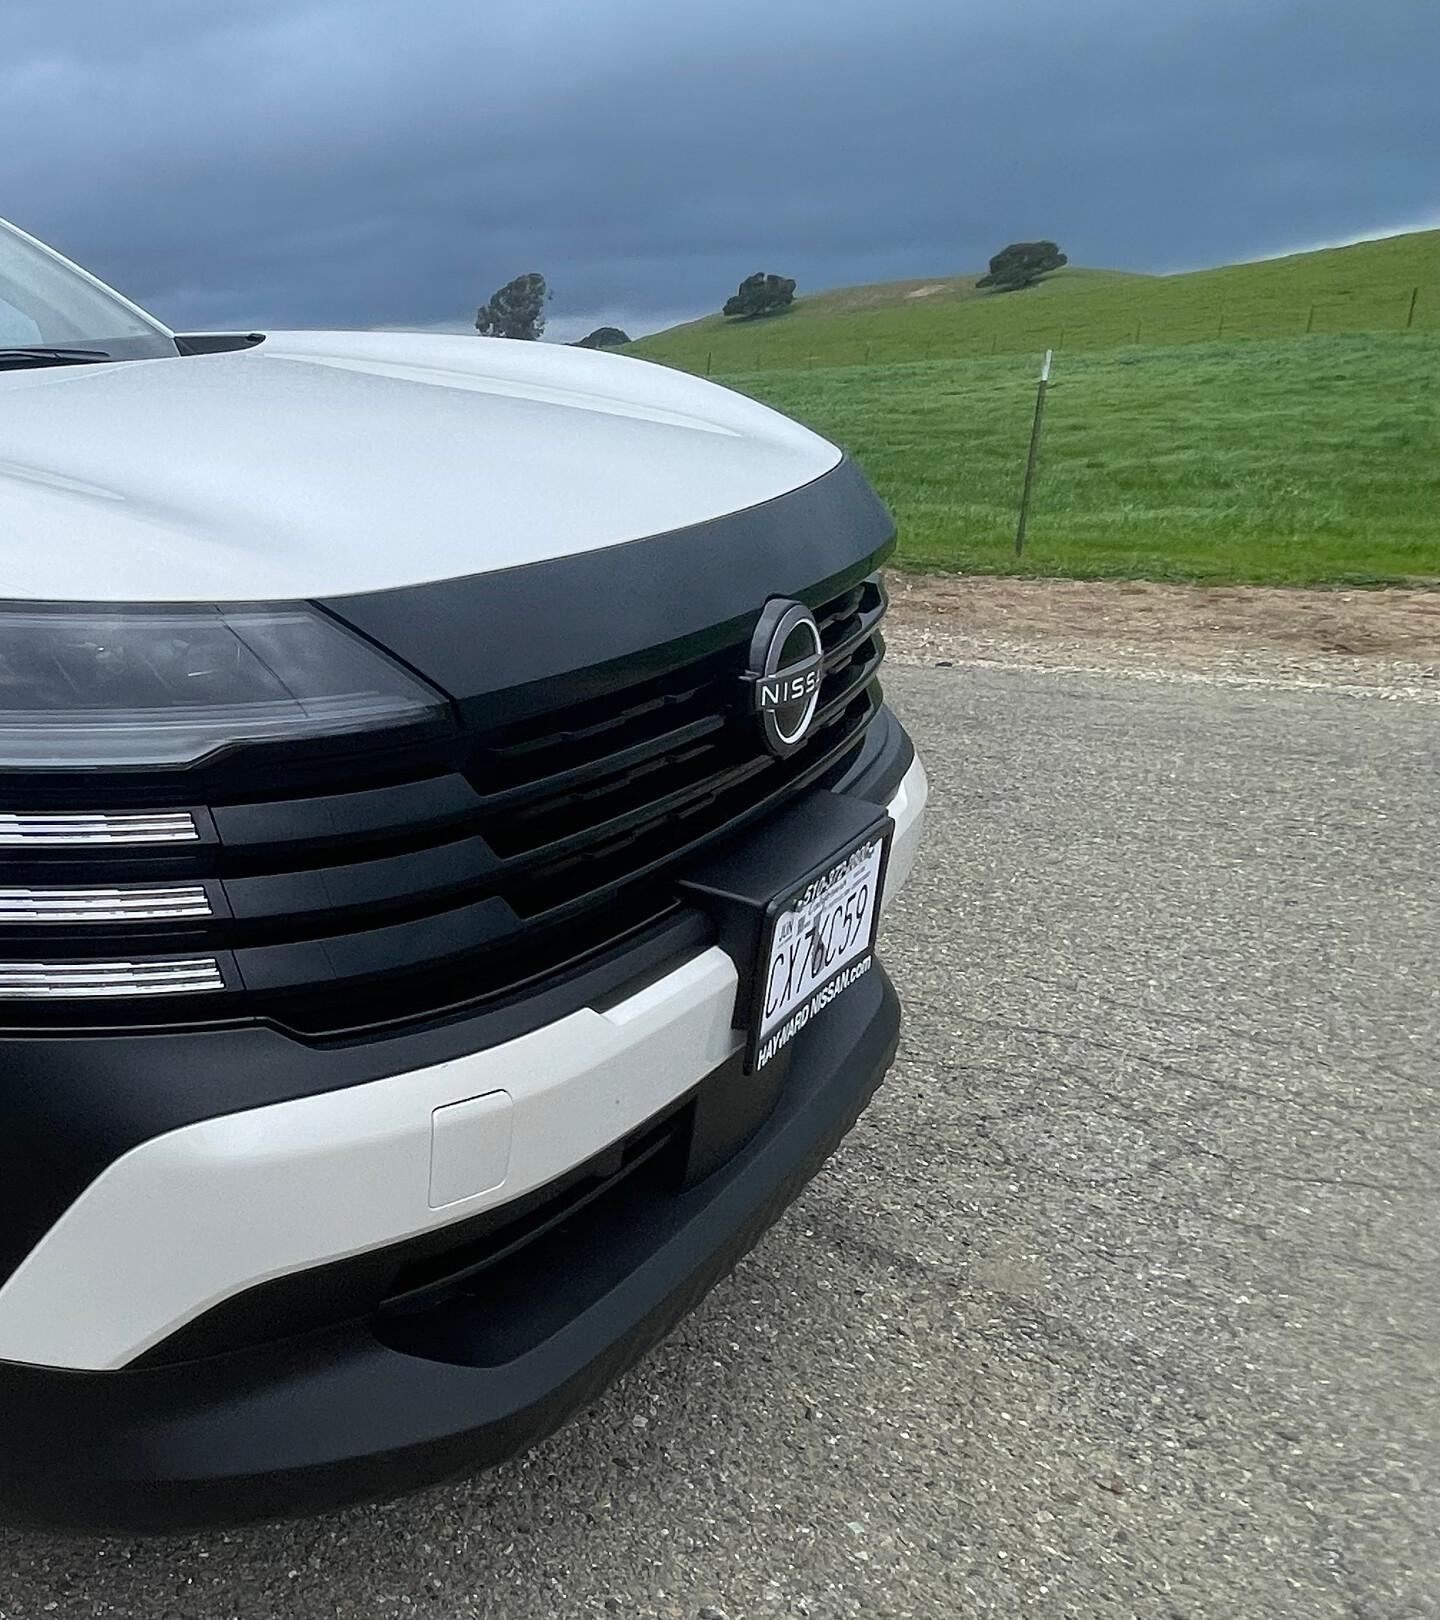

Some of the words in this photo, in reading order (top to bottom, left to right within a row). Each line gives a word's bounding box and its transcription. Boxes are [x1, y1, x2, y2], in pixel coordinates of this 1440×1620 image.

[762, 671, 819, 706] NISS
[766, 884, 868, 1018] CX76C59
[757, 1004, 810, 1071] HAYWARD
[810, 955, 872, 1018] NISSAN.com
